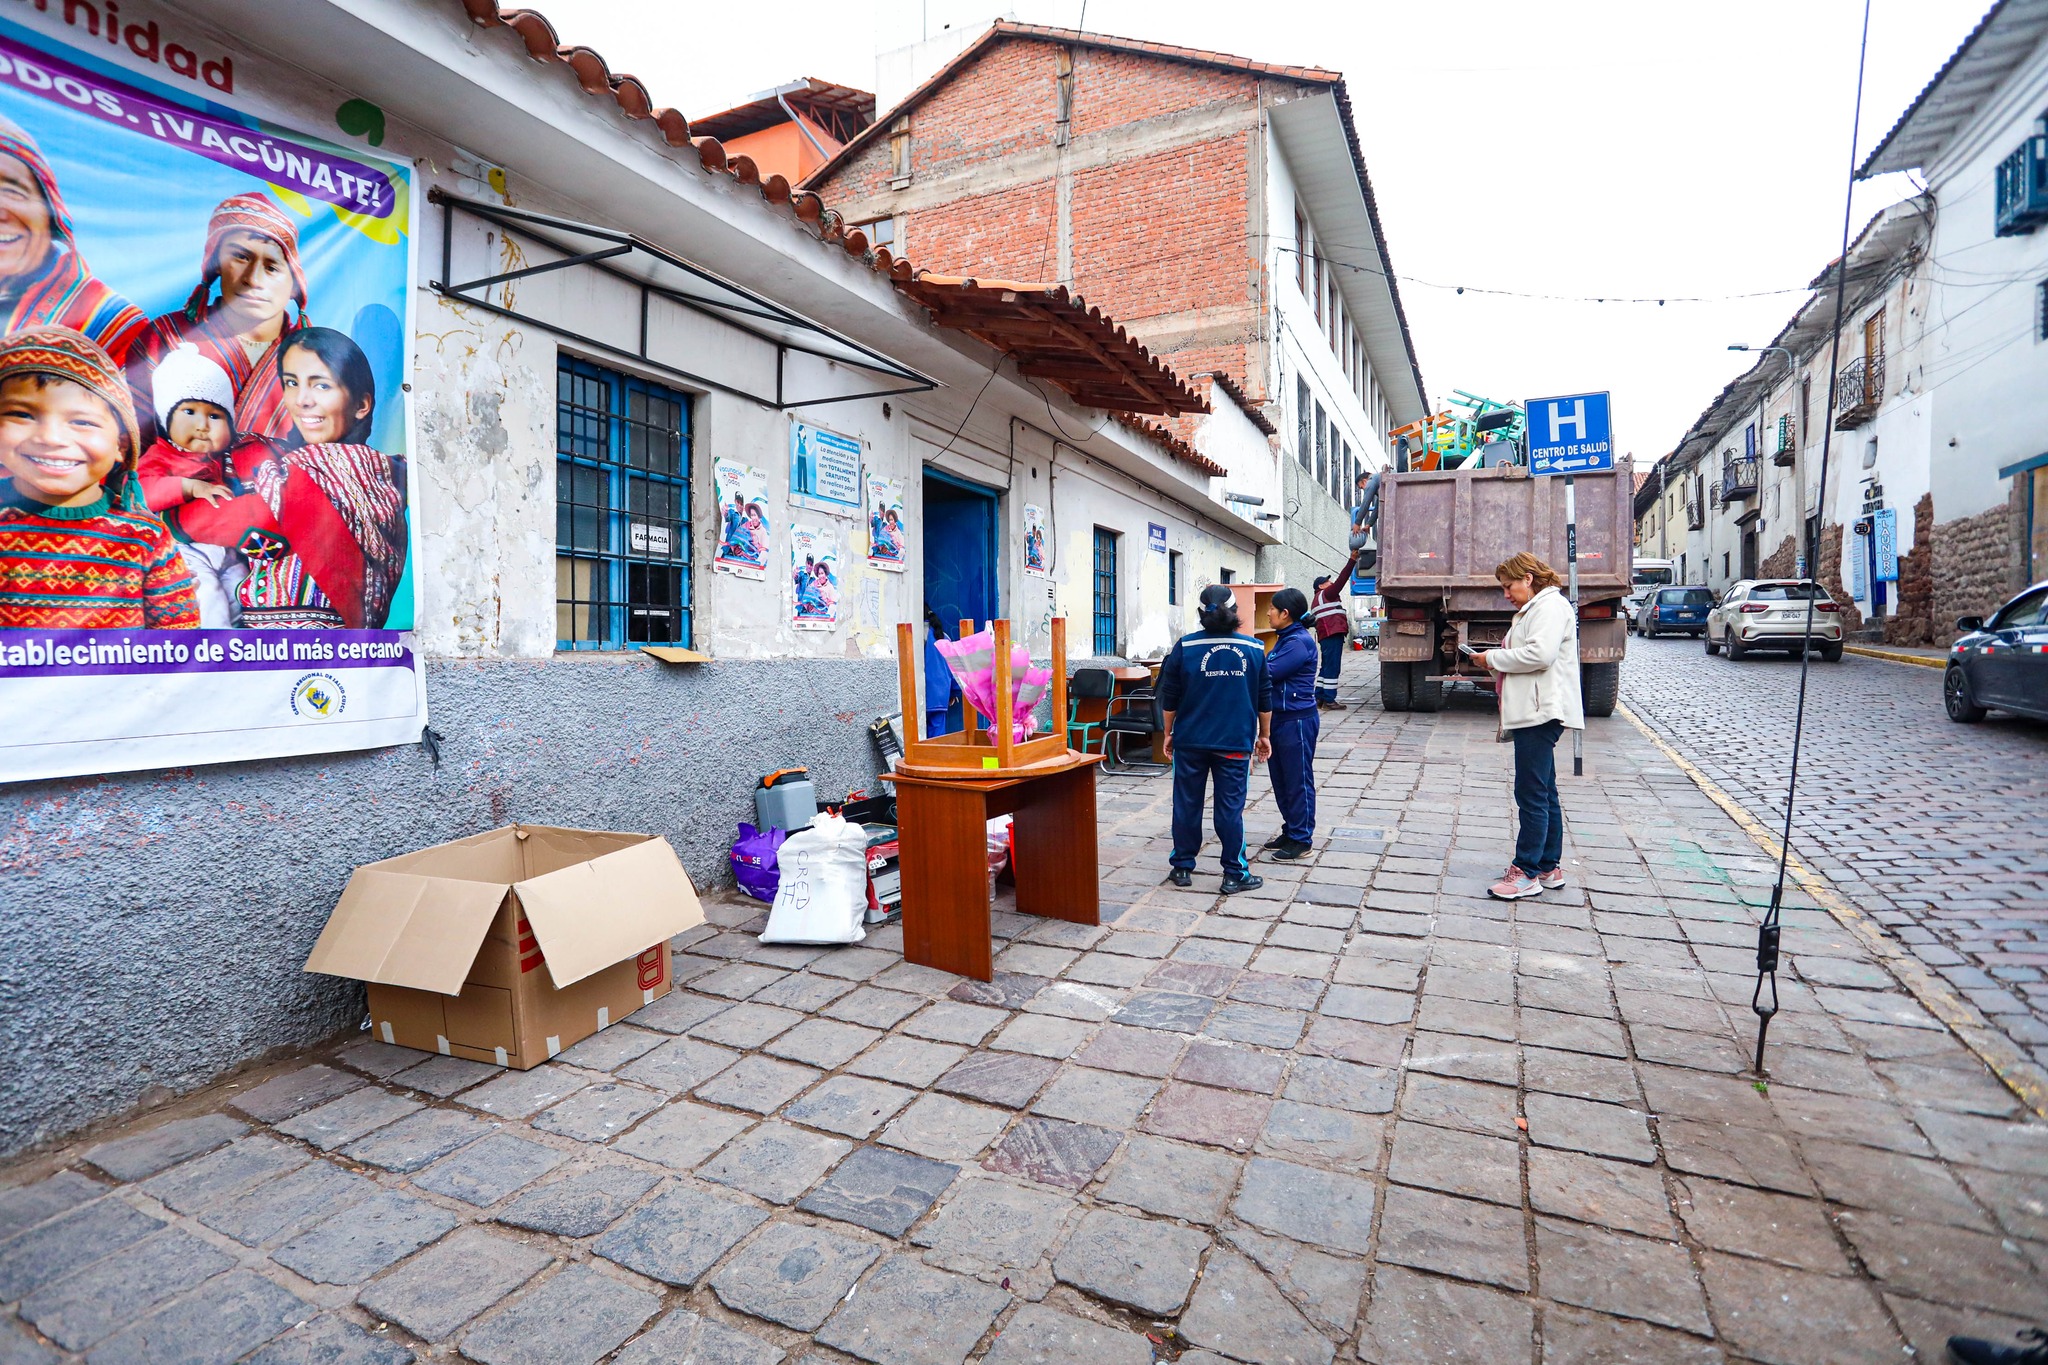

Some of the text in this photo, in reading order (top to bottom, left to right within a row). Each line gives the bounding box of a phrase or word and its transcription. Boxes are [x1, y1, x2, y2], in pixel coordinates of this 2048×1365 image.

[147, 111, 383, 209] ¡VACÚNATE!
[1548, 399, 1587, 442] H
[1532, 441, 1608, 459] CENTRO DE SALUD
[828, 465, 857, 477] TOTALMENTE
[635, 533, 668, 544] FARMACIA
[1881, 519, 1891, 578] LAUNDRY
[194, 638, 224, 662] de
[229, 637, 289, 662] Salud
[293, 637, 334, 660] más
[337, 641, 403, 659] cercano
[296, 672, 323, 687] REGIONAL
